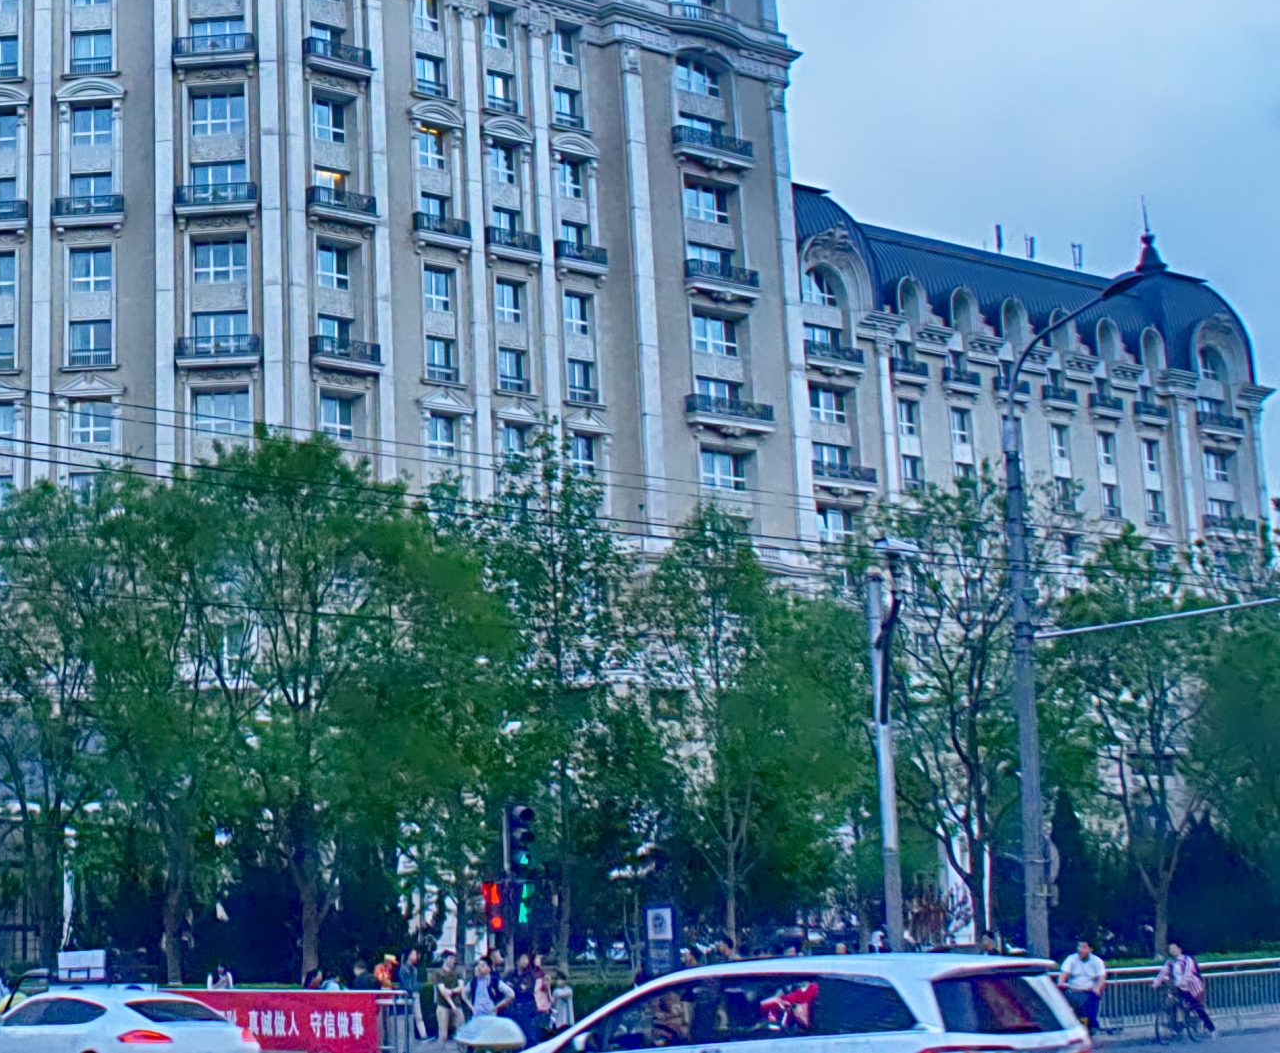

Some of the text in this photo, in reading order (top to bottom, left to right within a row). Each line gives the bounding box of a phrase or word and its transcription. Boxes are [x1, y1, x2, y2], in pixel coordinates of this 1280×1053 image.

[248, 1009, 300, 1037] 真诚做人
[310, 1010, 365, 1040] 守信做事
